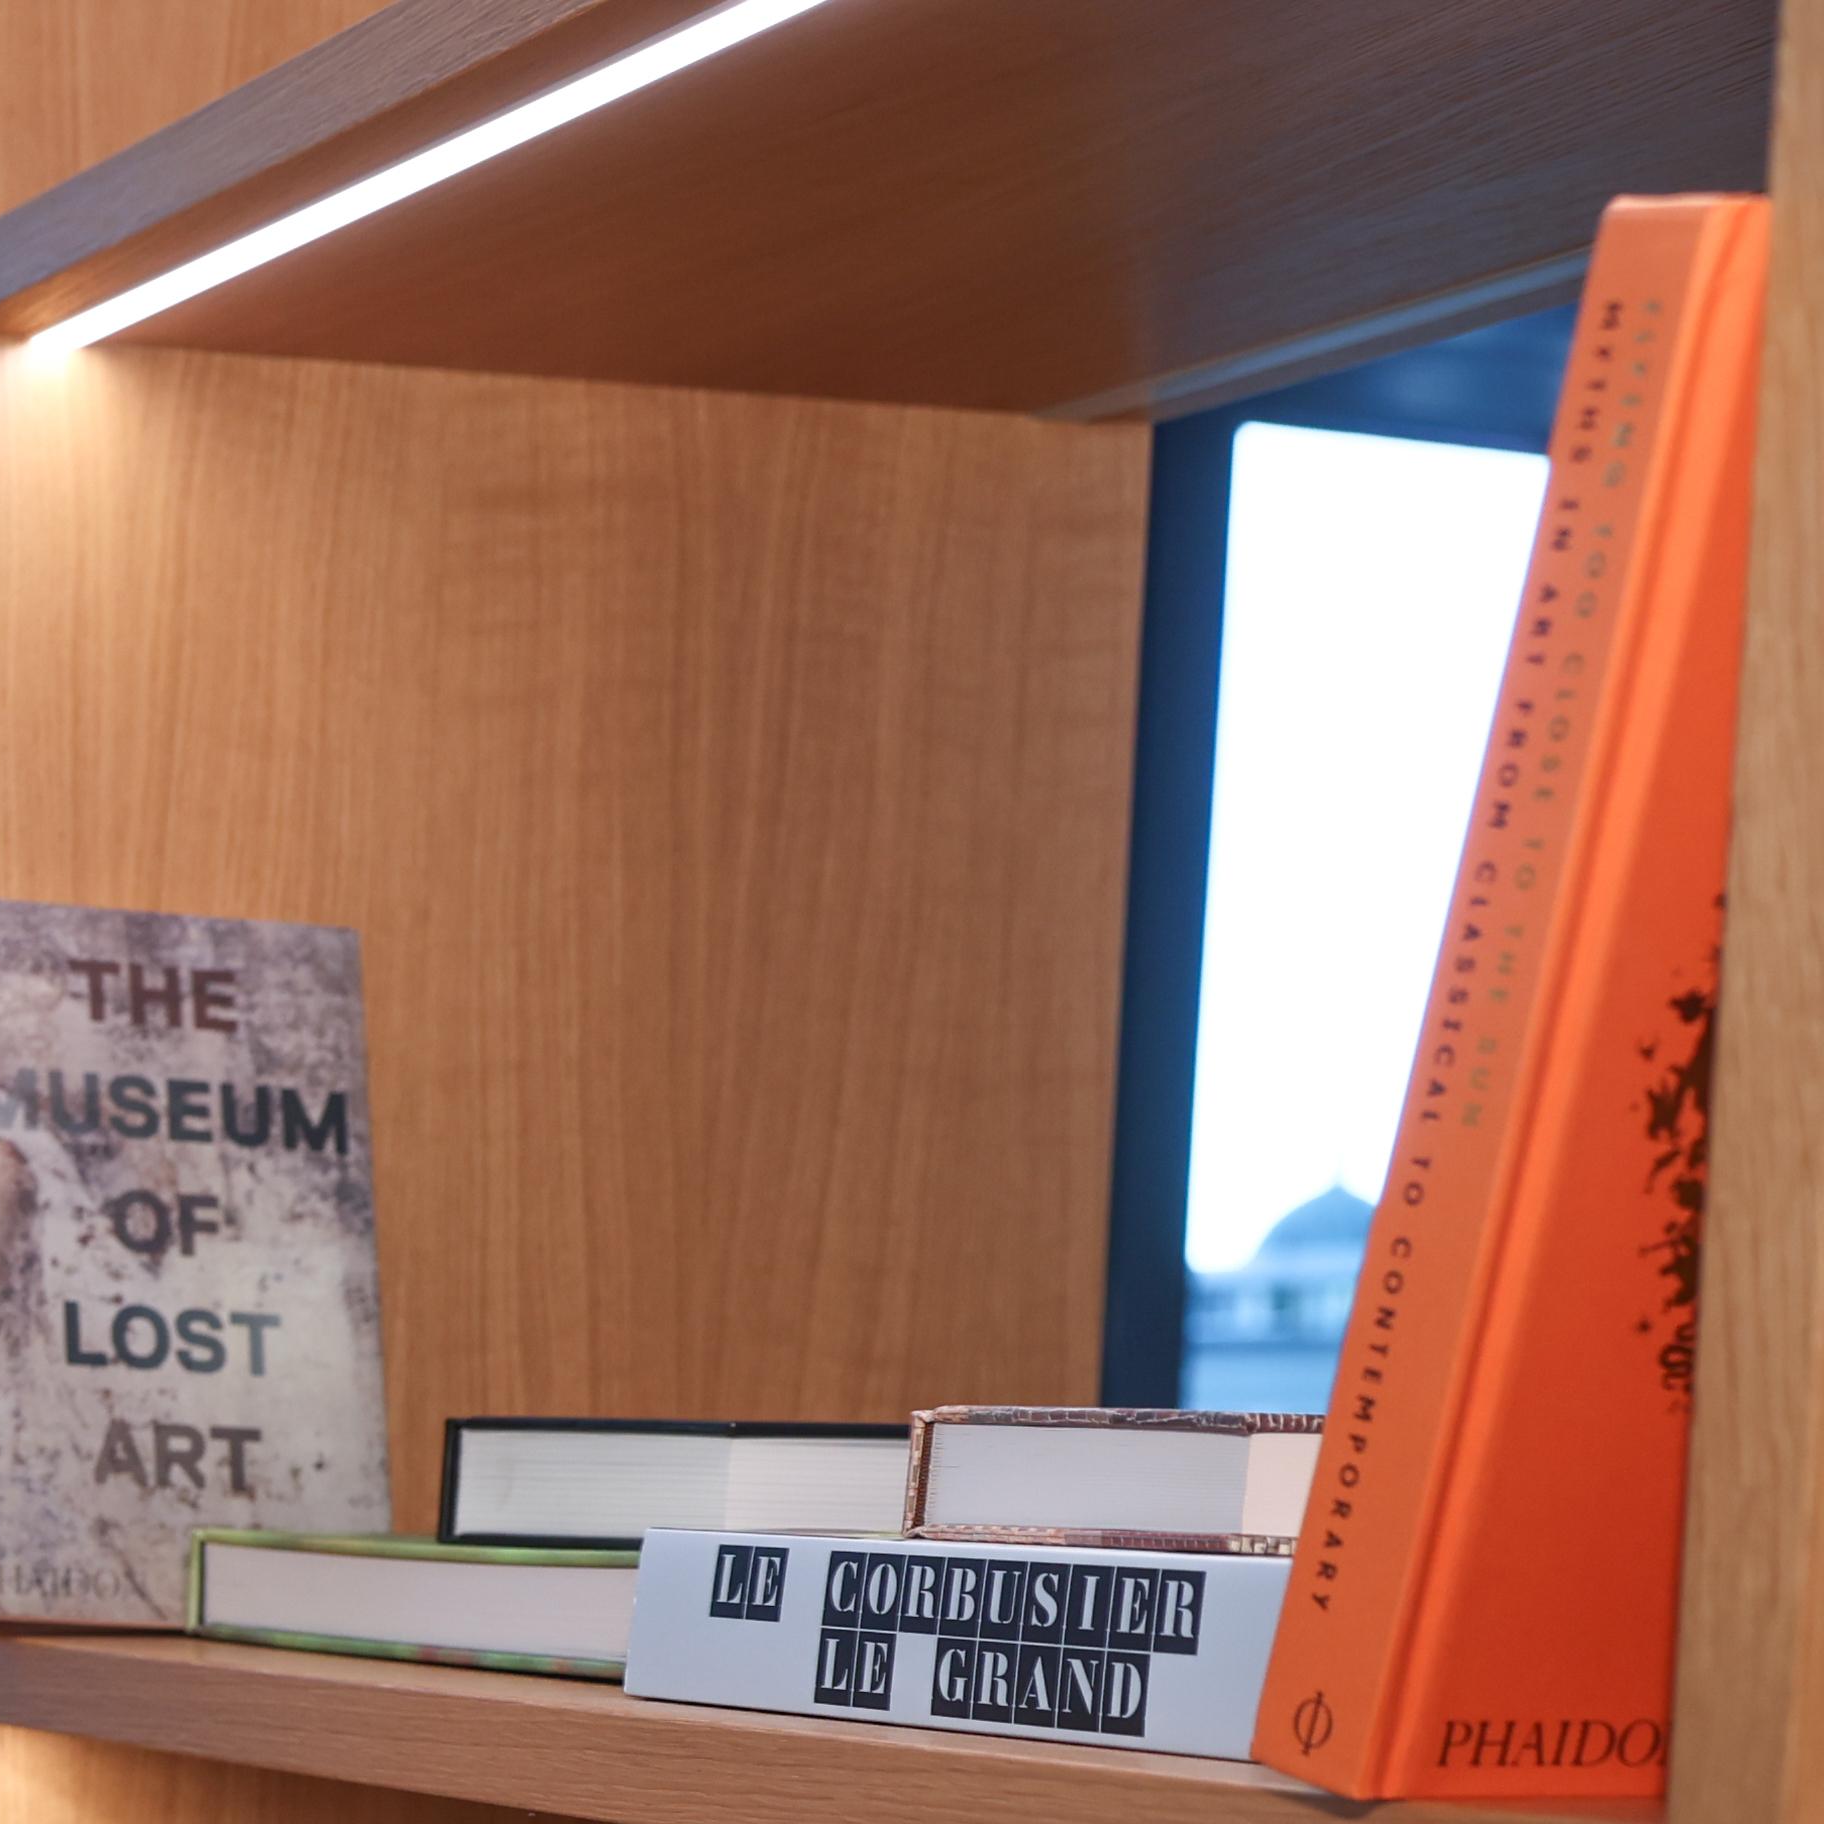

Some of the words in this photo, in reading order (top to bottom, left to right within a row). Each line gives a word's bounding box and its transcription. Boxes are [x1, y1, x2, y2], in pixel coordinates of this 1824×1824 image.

[1569, 299, 1624, 464] MYTHS
[1553, 499, 1581, 551] IN
[1525, 582, 1559, 666] ART
[1488, 698, 1536, 830] FROM
[1514, 836, 1546, 892] TO
[67, 958, 239, 1034] THE
[1420, 860, 1498, 1122] CLASSICAL
[1404, 1156, 1433, 1206] TO
[111, 1188, 220, 1257] OF
[63, 1300, 282, 1377] LOST
[94, 1418, 263, 1497] ART
[1312, 1235, 1412, 1611] CONTEMPORARY
[714, 1551, 786, 1611] LE
[828, 1558, 1199, 1641] CORBUSIER
[819, 1635, 892, 1698] LE
[937, 1646, 1147, 1722] GRAND
[1436, 1717, 1667, 1768] PHAIDO
